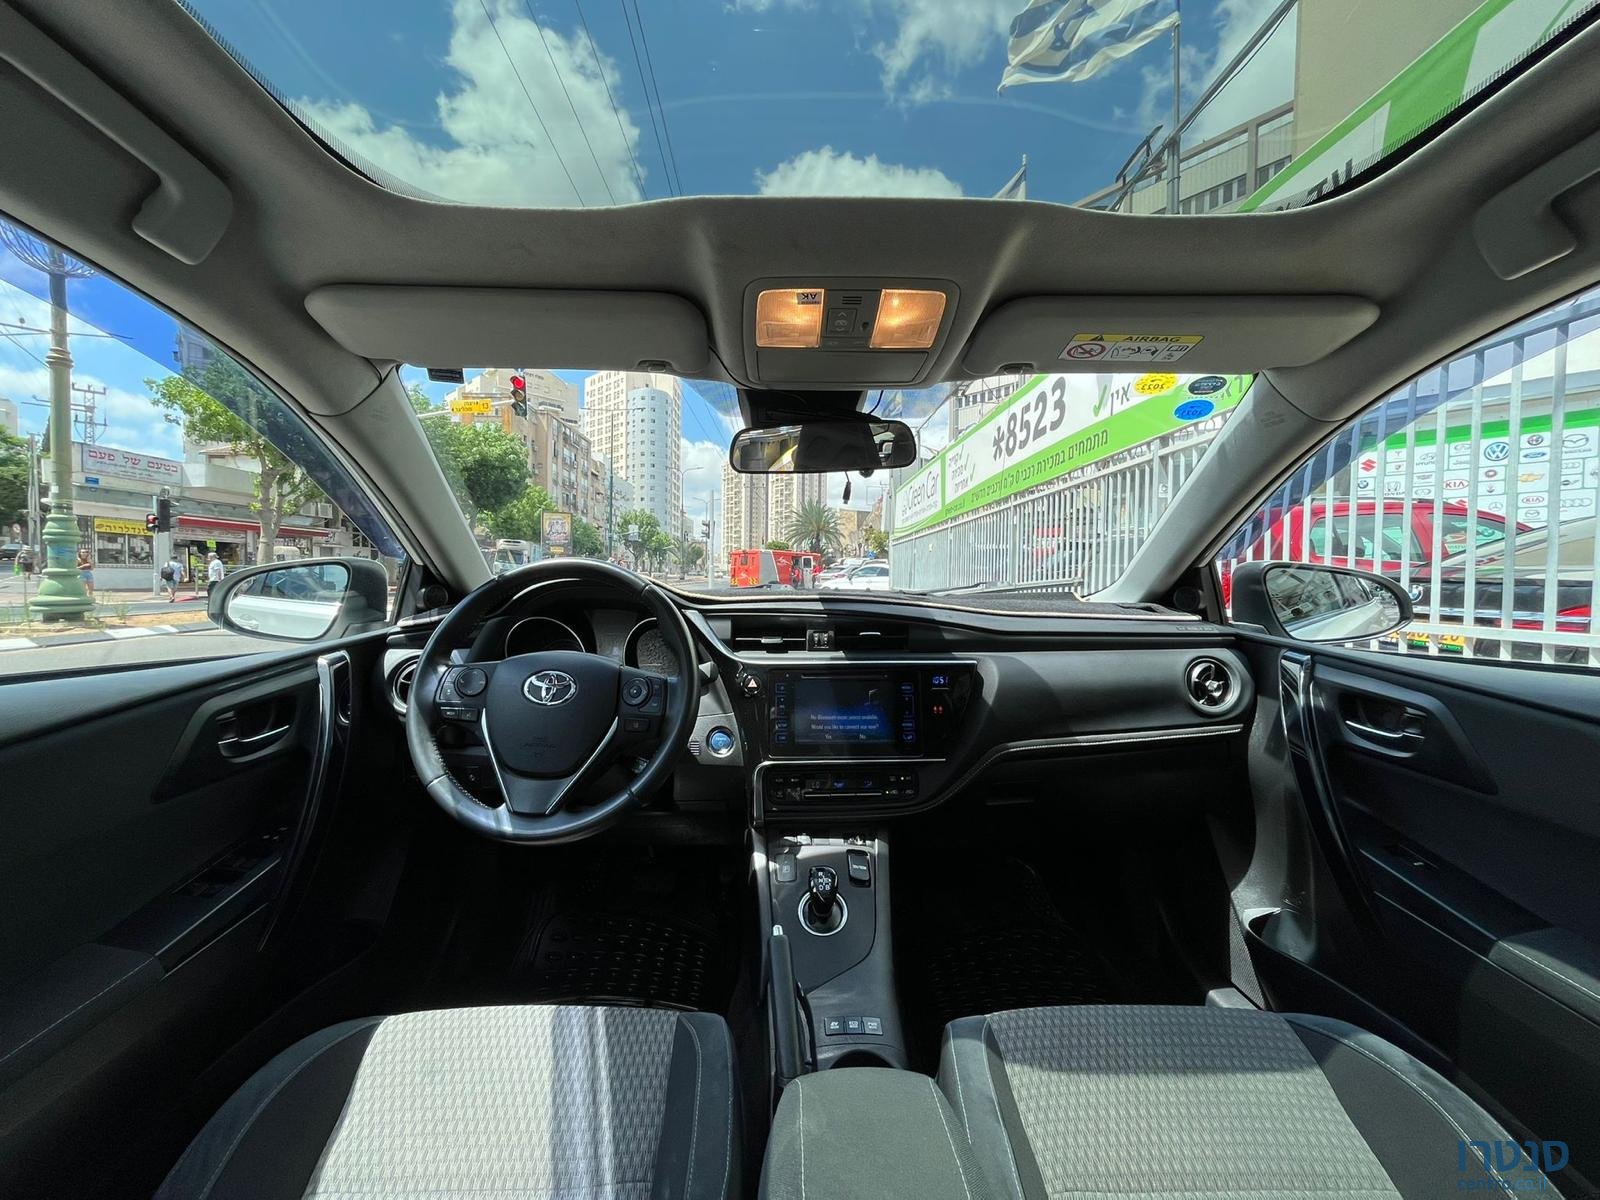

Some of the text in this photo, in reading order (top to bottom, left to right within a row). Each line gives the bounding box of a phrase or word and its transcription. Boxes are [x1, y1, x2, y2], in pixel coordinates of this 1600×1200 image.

[1068, 429, 1109, 461] מתמחים
[88, 449, 115, 461] פעם
[122, 454, 141, 466] של
[147, 460, 178, 473] בטעם
